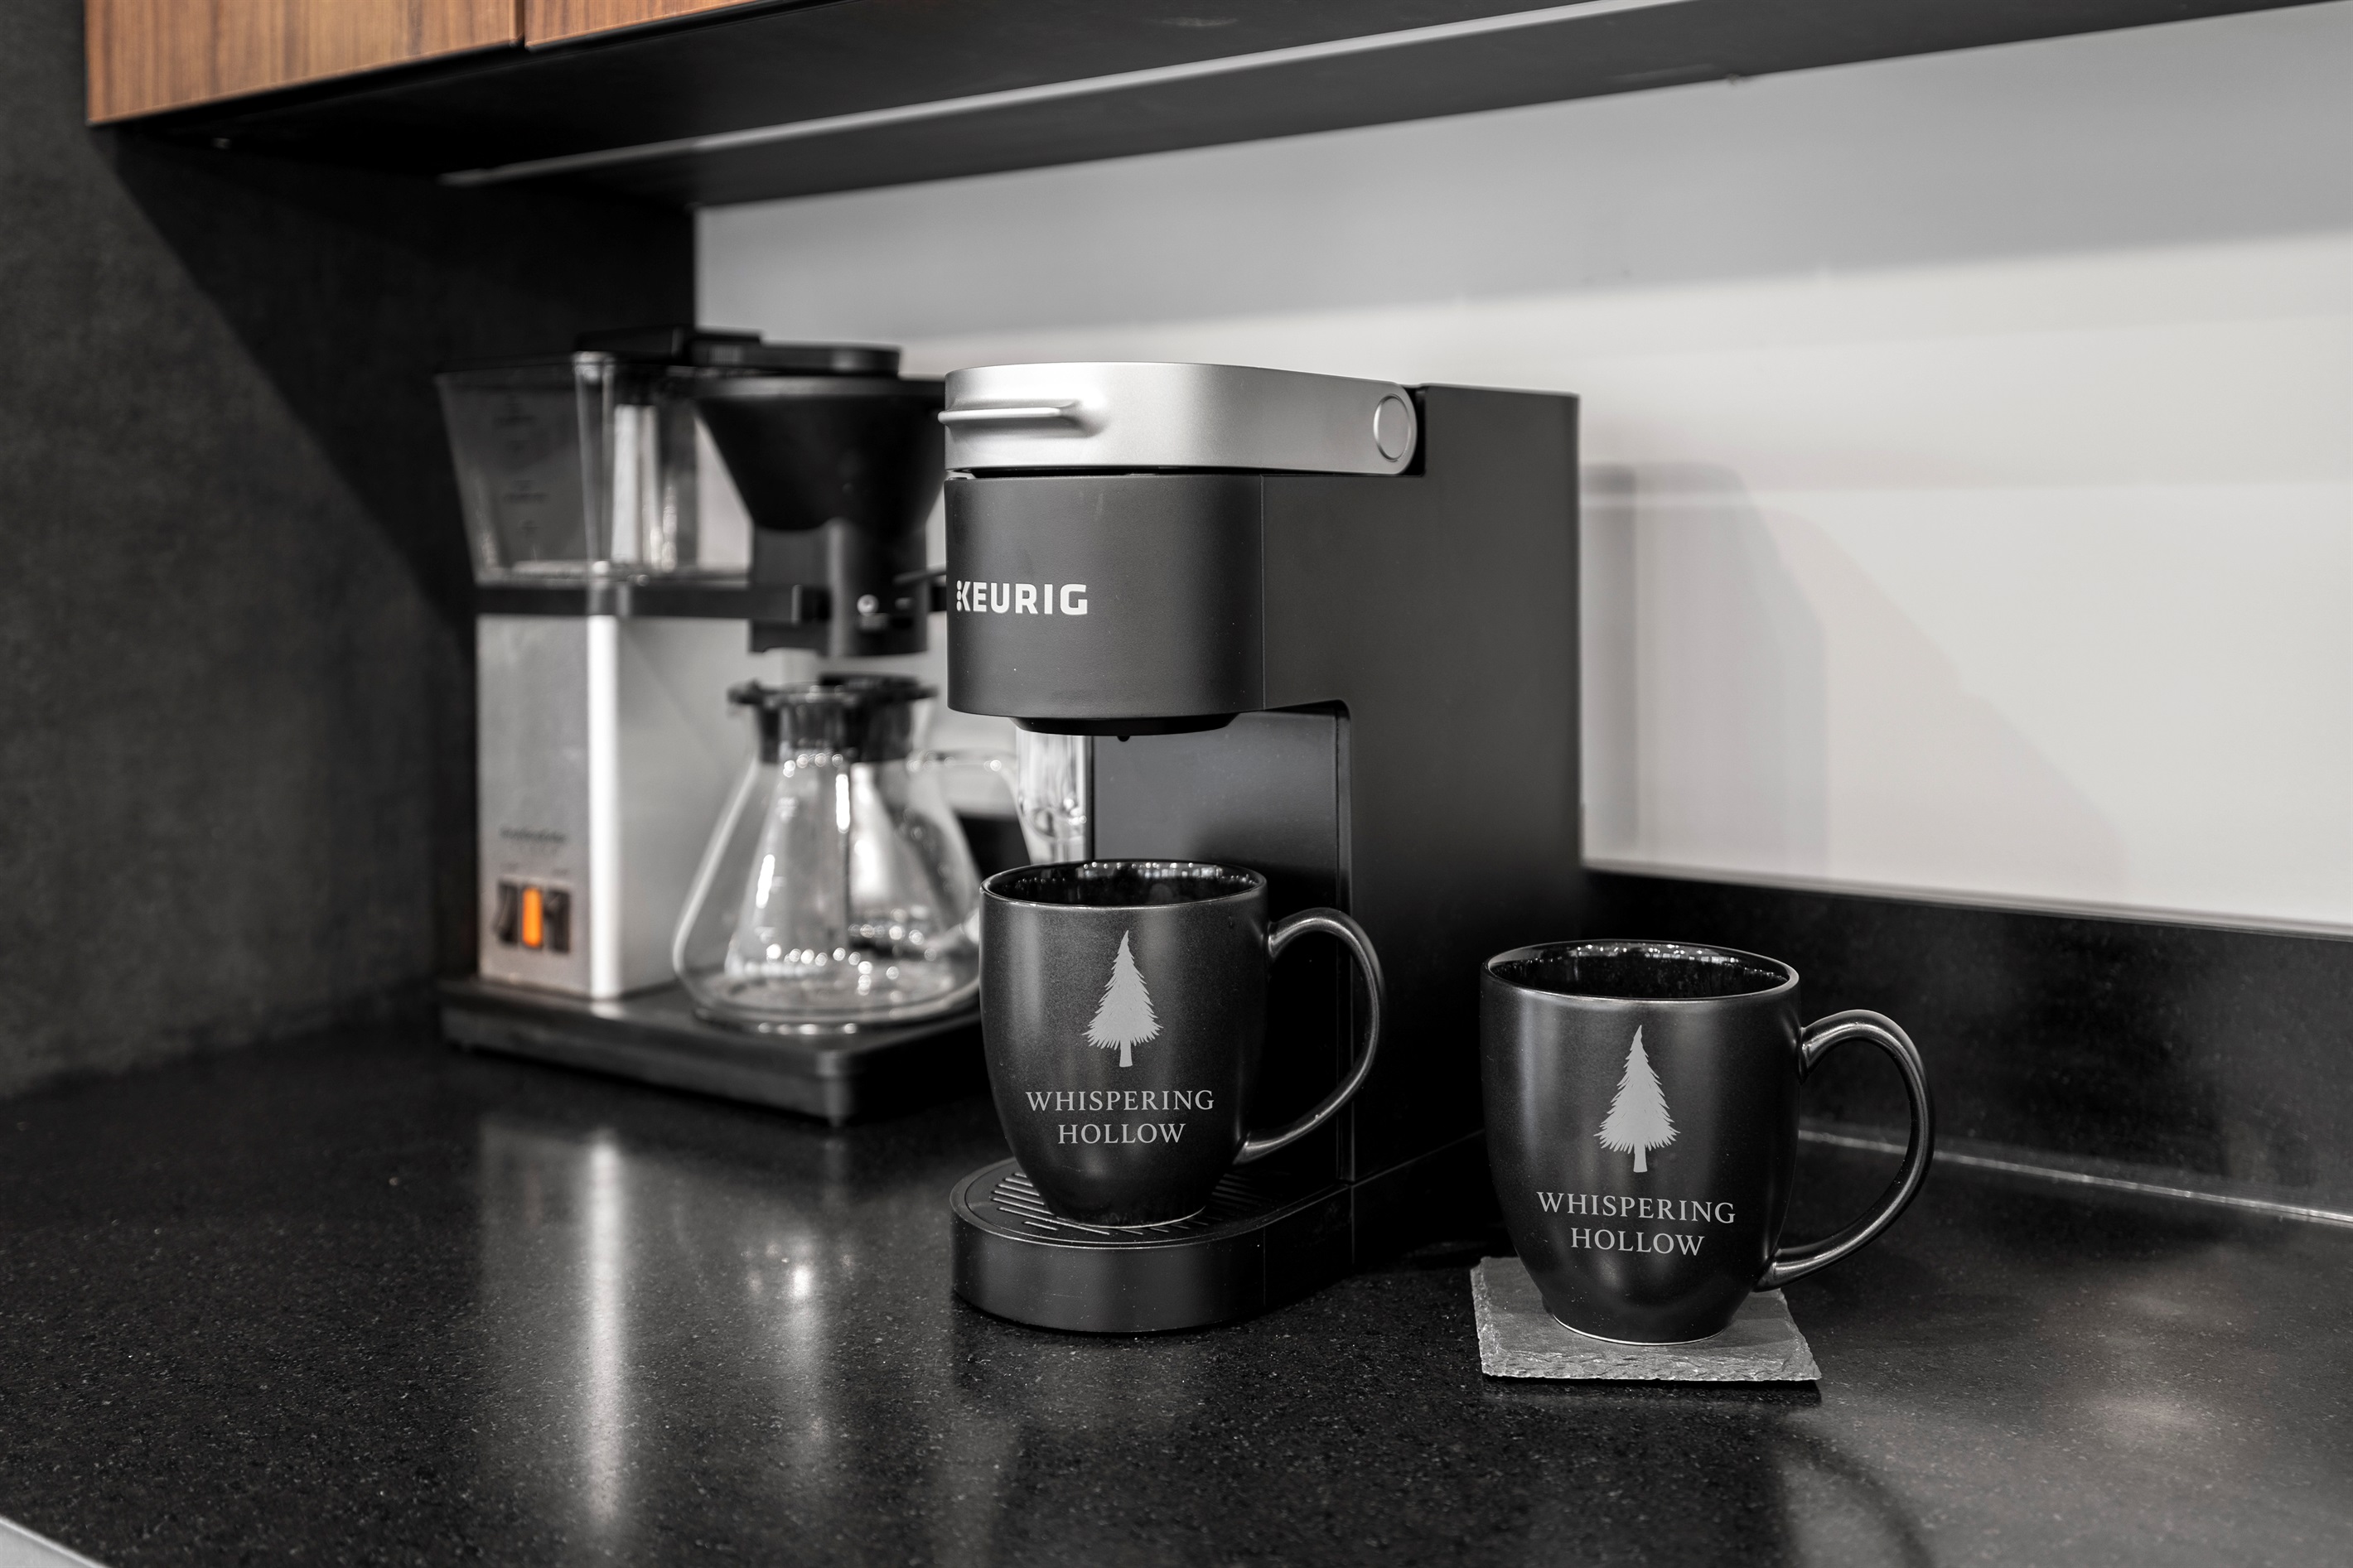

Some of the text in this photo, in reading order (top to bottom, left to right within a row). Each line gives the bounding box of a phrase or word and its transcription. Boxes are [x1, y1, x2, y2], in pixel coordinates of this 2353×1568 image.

[956, 580, 1088, 615] KEURIG
[1025, 1089, 1215, 1112] WHISPERING
[1058, 1122, 1186, 1145] HOLLOW
[1536, 1191, 1737, 1223] WHISPERING
[1570, 1227, 1705, 1256] HOLLOW
